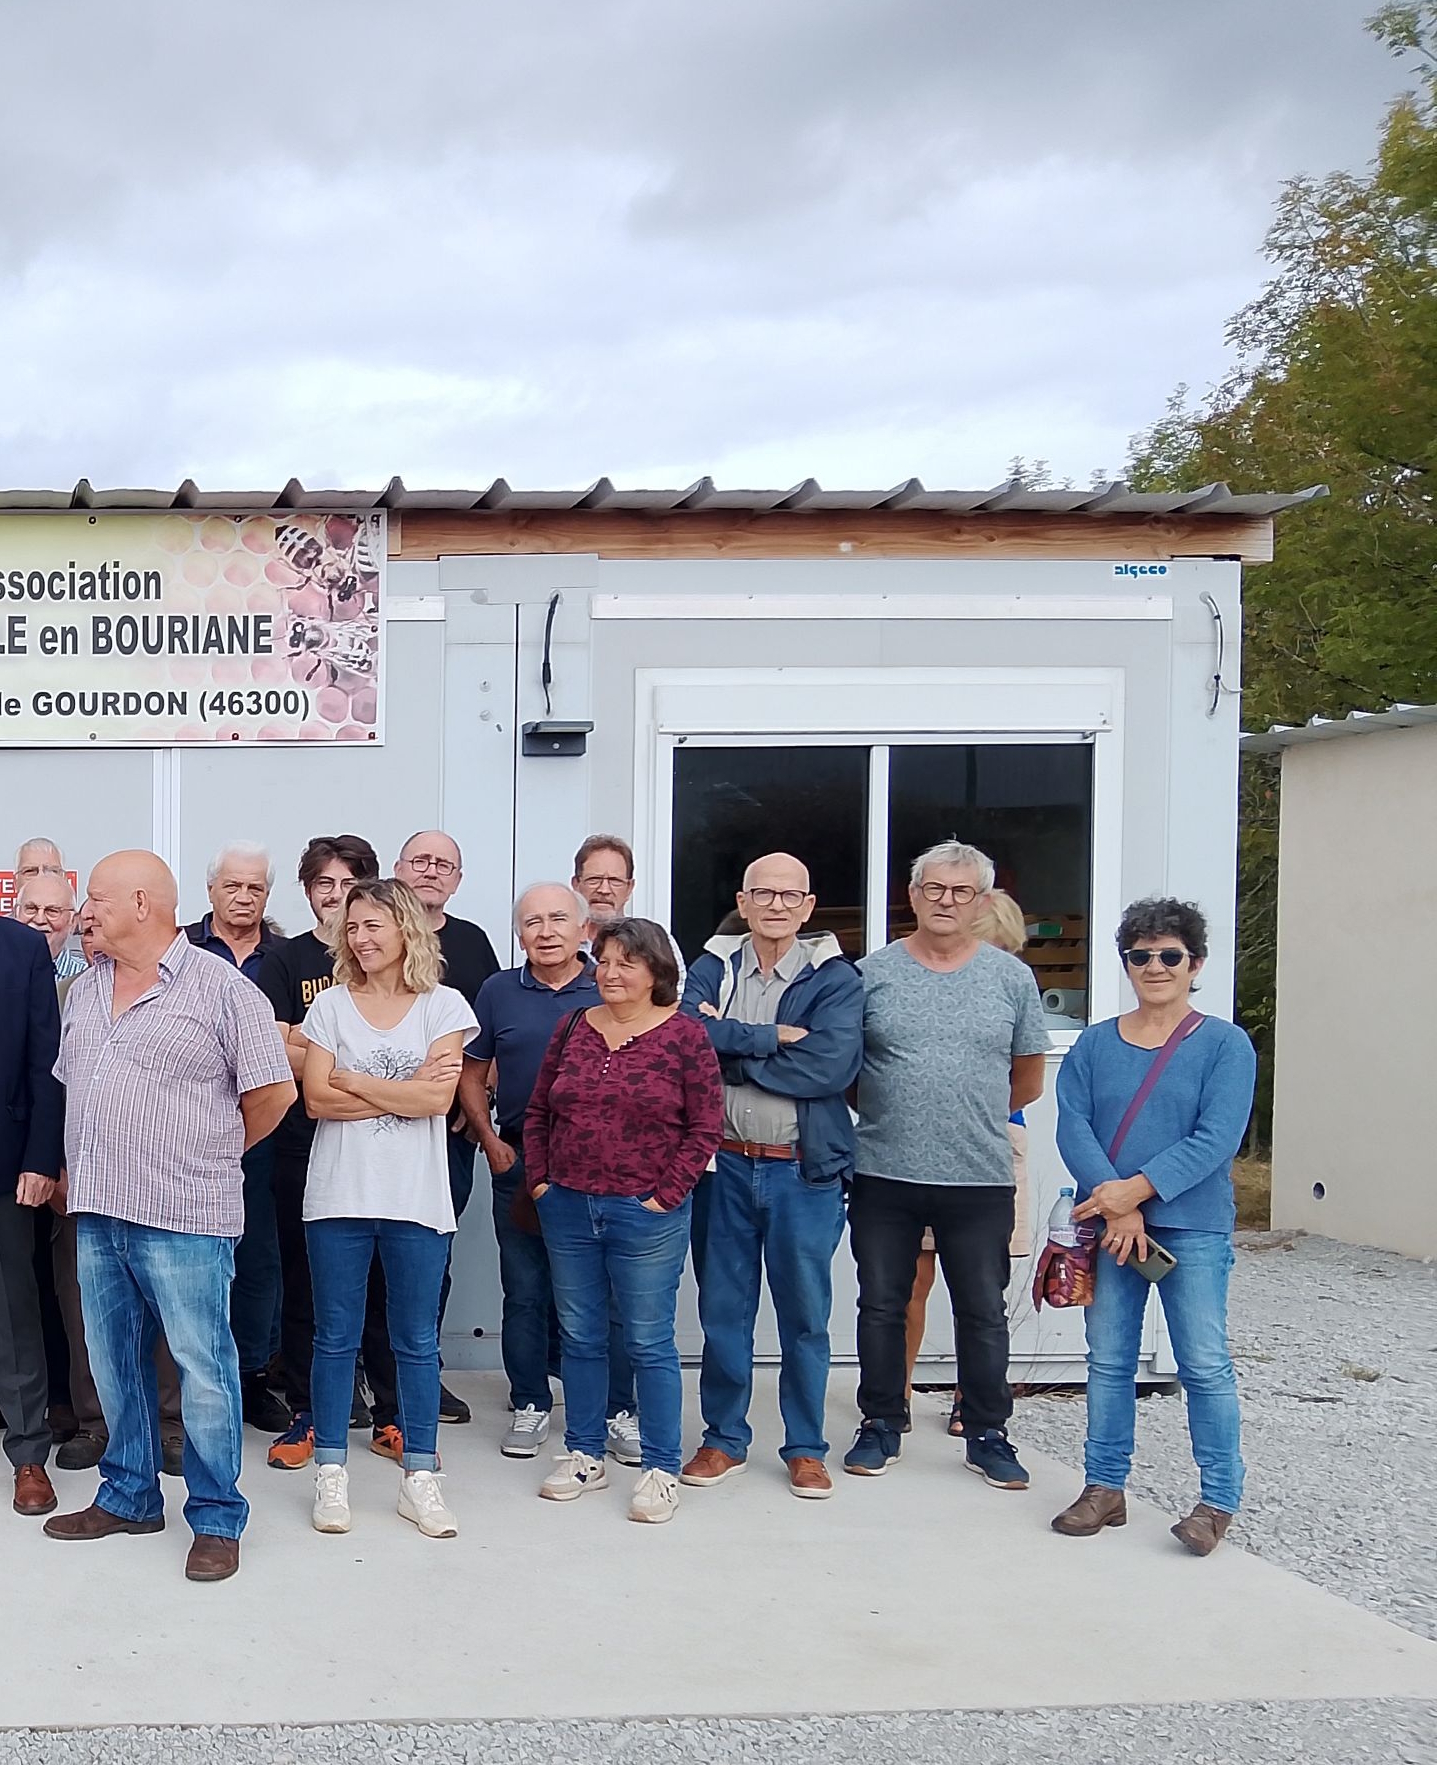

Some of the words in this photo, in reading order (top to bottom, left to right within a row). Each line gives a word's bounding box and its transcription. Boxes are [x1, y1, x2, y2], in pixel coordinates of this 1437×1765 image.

[1114, 564, 1167, 579] algeco
[39, 625, 78, 655] en
[92, 615, 273, 655] BOURIANE
[32, 691, 187, 716] GOURDON
[199, 690, 309, 723] (46300)
